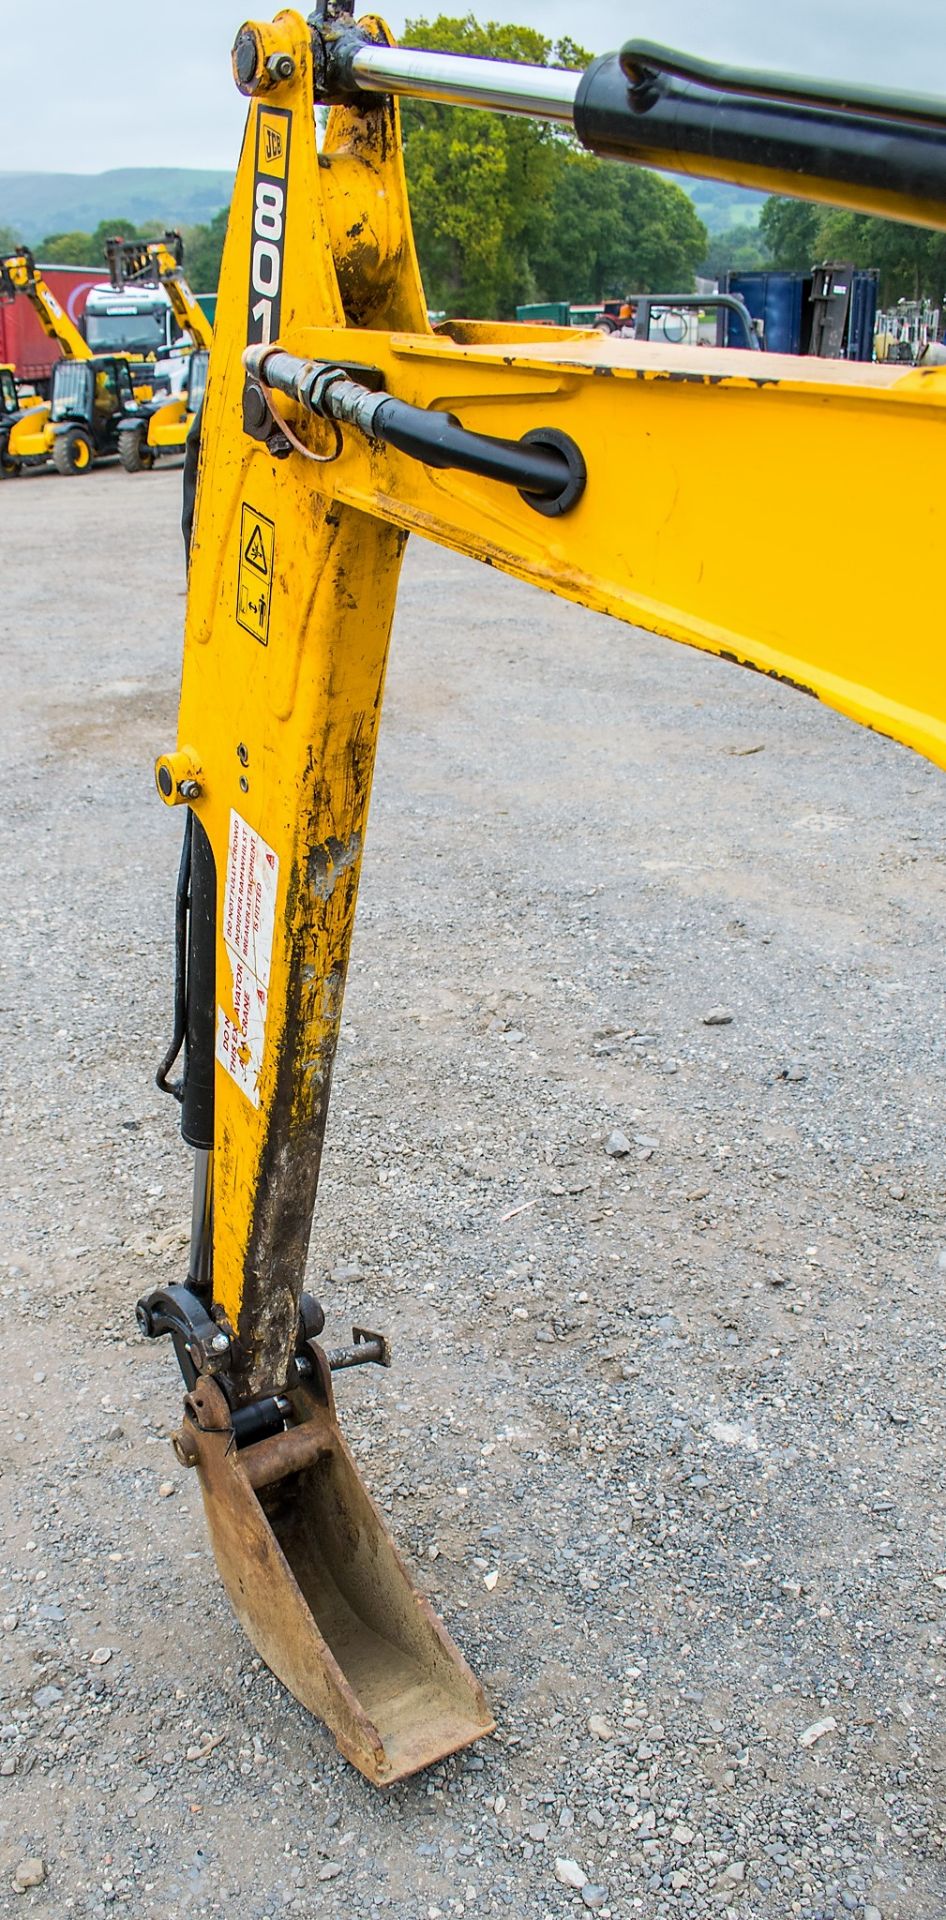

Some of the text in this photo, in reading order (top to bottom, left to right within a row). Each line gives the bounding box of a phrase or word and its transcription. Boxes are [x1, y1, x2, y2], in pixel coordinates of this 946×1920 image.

[266, 129, 282, 159] JCB
[253, 182, 284, 346] 801
[246, 836, 256, 910] ATTACHMENT
[226, 920, 232, 938] DO
[253, 883, 262, 932] IS FITTED
[241, 990, 250, 1037] CRANE
[222, 1030, 229, 1051] DO
